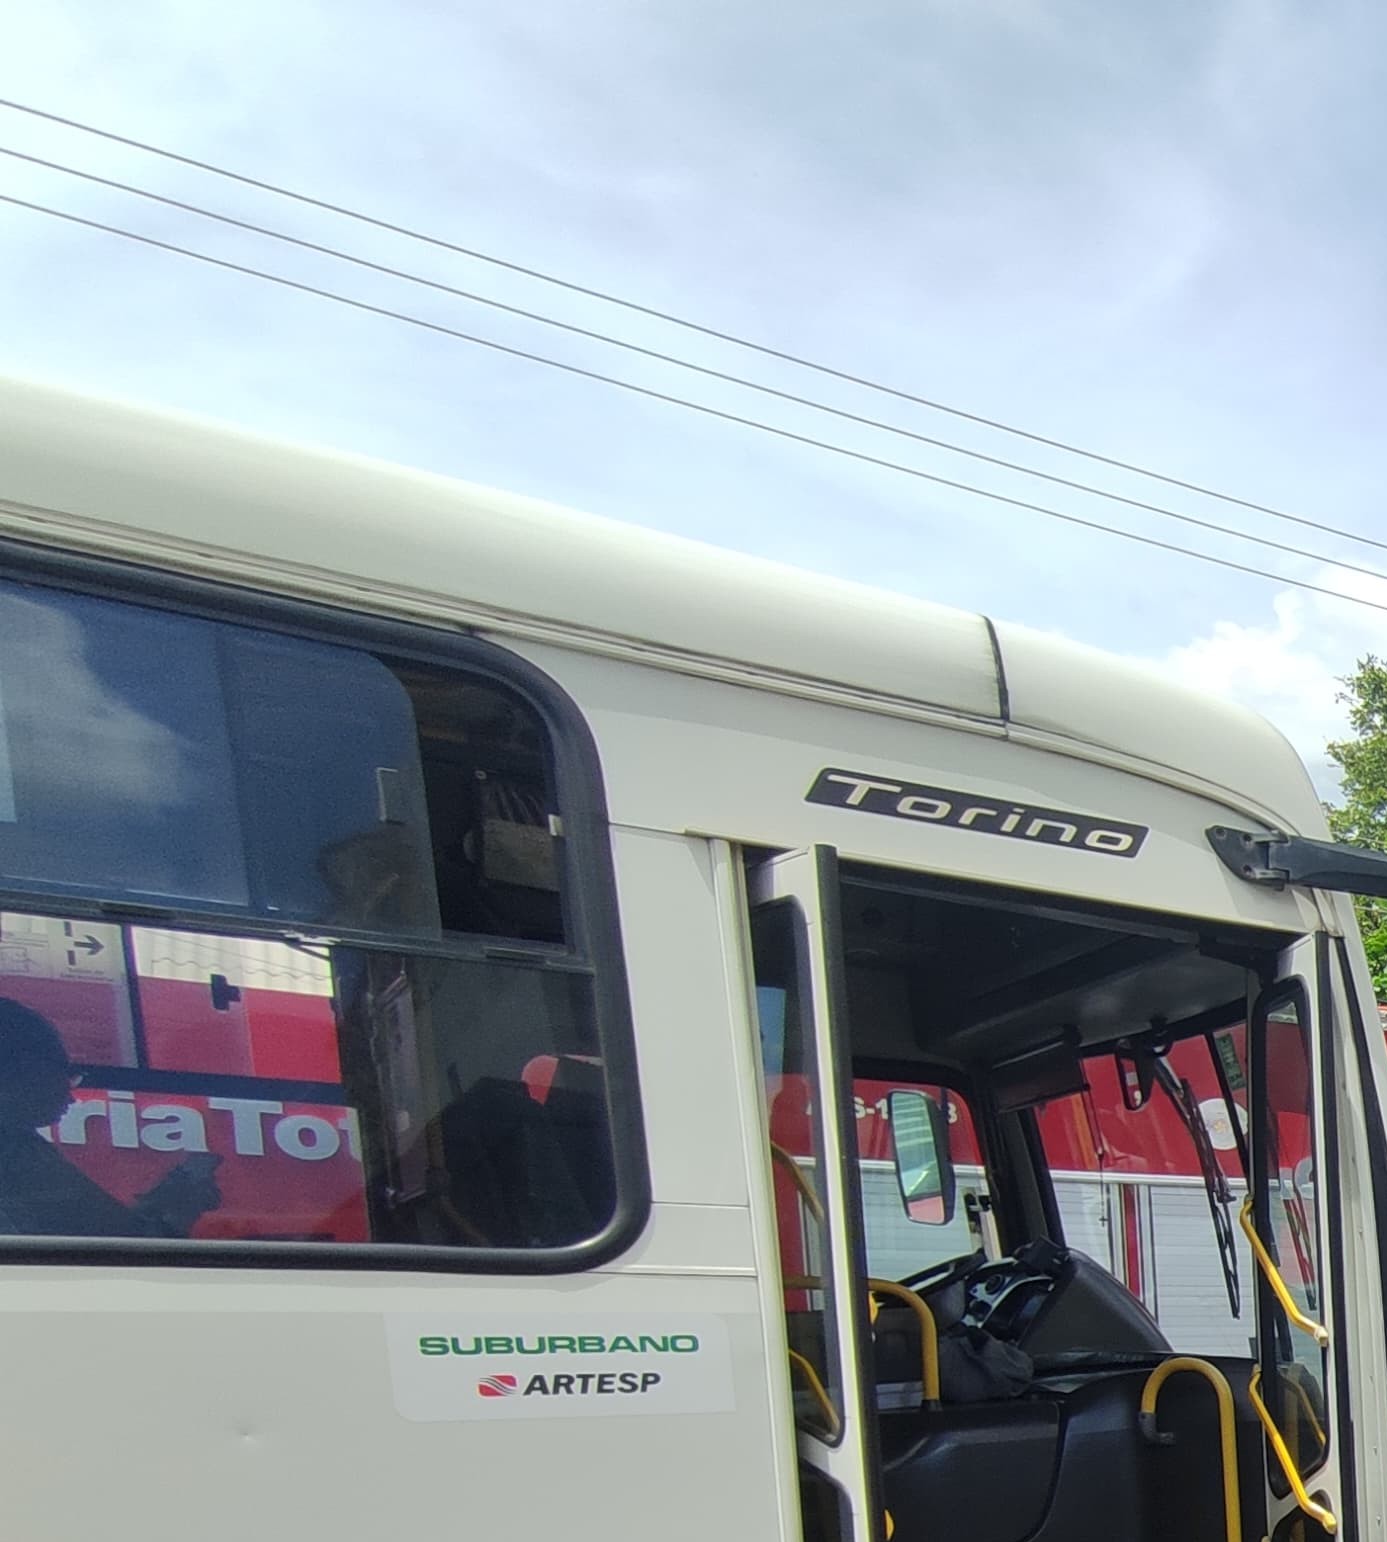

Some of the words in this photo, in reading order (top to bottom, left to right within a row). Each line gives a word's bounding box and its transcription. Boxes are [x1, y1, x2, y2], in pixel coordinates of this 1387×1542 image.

[828, 774, 1134, 852] Torino
[419, 1335, 699, 1356] SUBURBANO
[522, 1373, 661, 1396] ARTESP
